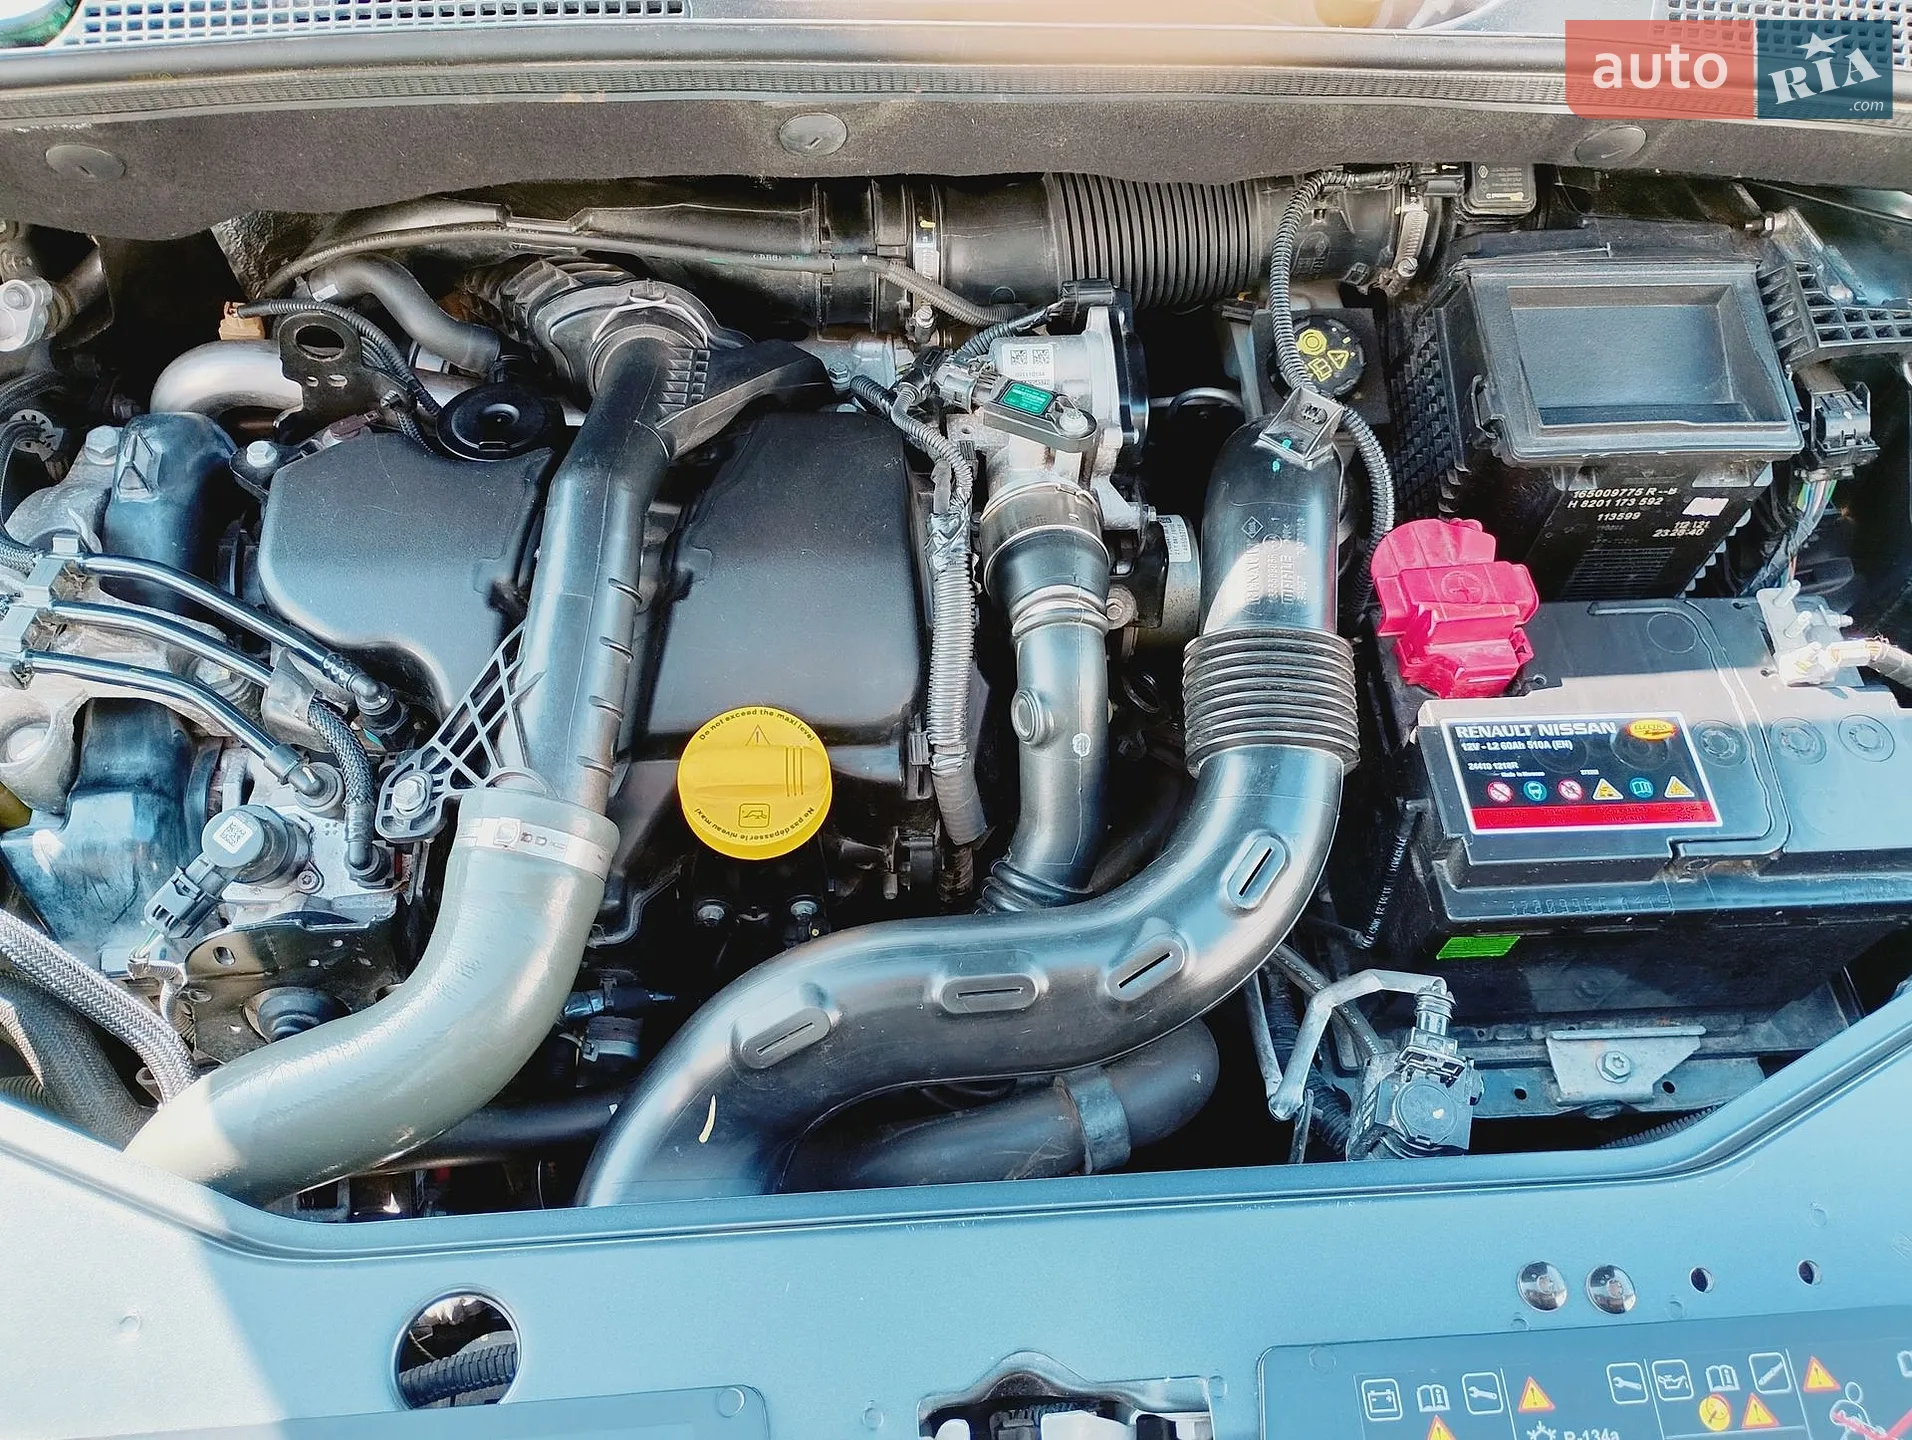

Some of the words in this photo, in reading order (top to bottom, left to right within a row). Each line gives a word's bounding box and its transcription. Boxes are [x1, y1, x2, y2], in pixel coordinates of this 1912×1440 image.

[1567, 499, 1578, 509] H
[1579, 499, 1611, 509] 8201
[1614, 498, 1636, 507] 173
[1638, 497, 1664, 507] 592
[1597, 511, 1642, 522] 113599
[700, 730, 710, 741] Do
[711, 719, 724, 731] not
[725, 709, 757, 722] exceed
[760, 709, 774, 717] the
[777, 713, 798, 726] maxi
[1454, 724, 1533, 739] RENAULT
[1537, 722, 1617, 737] NISSAN
[1461, 742, 1481, 752] 12V
[804, 807, 815, 818] Ne
[791, 816, 804, 831] pas
[713, 823, 738, 839] niveau
